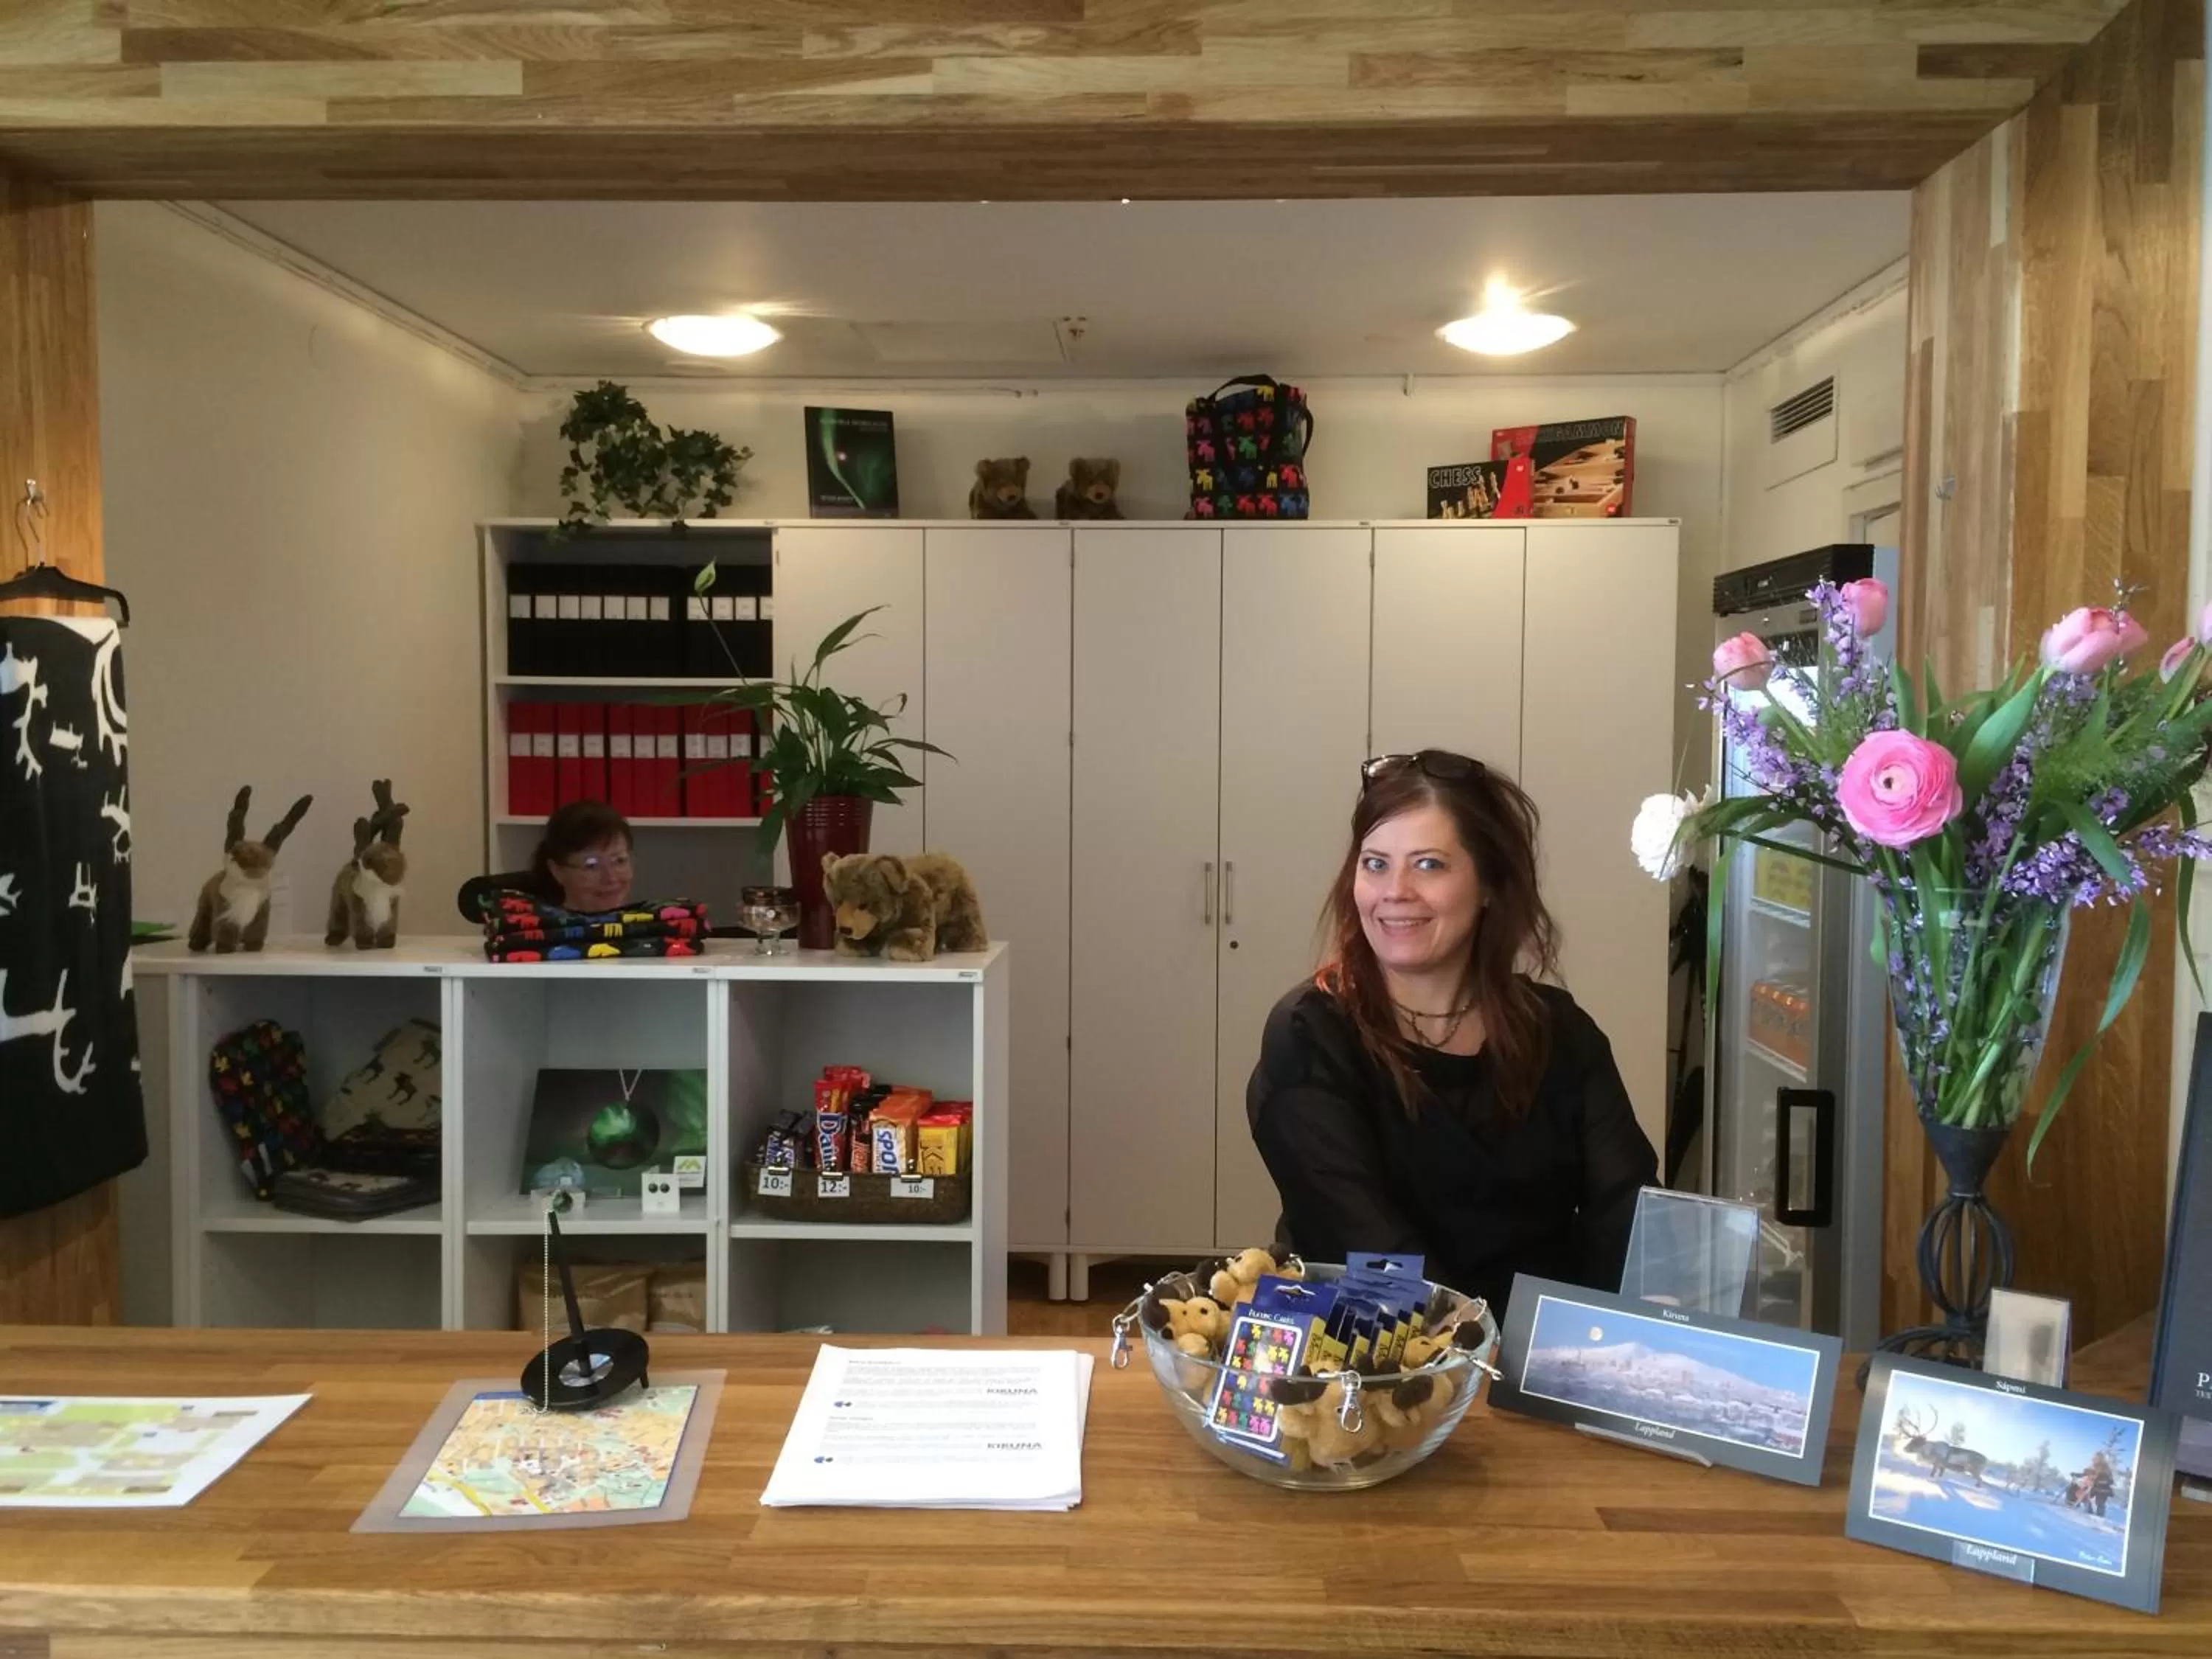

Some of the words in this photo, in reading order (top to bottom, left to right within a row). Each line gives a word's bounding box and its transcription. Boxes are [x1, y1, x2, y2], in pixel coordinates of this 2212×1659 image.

[1430, 465, 1481, 488] CHESS
[762, 1177, 789, 1189] 10:-
[821, 1180, 847, 1192] 12:-
[2197, 1371, 2212, 1390] P
[1966, 1545, 2017, 1566] Lappland
